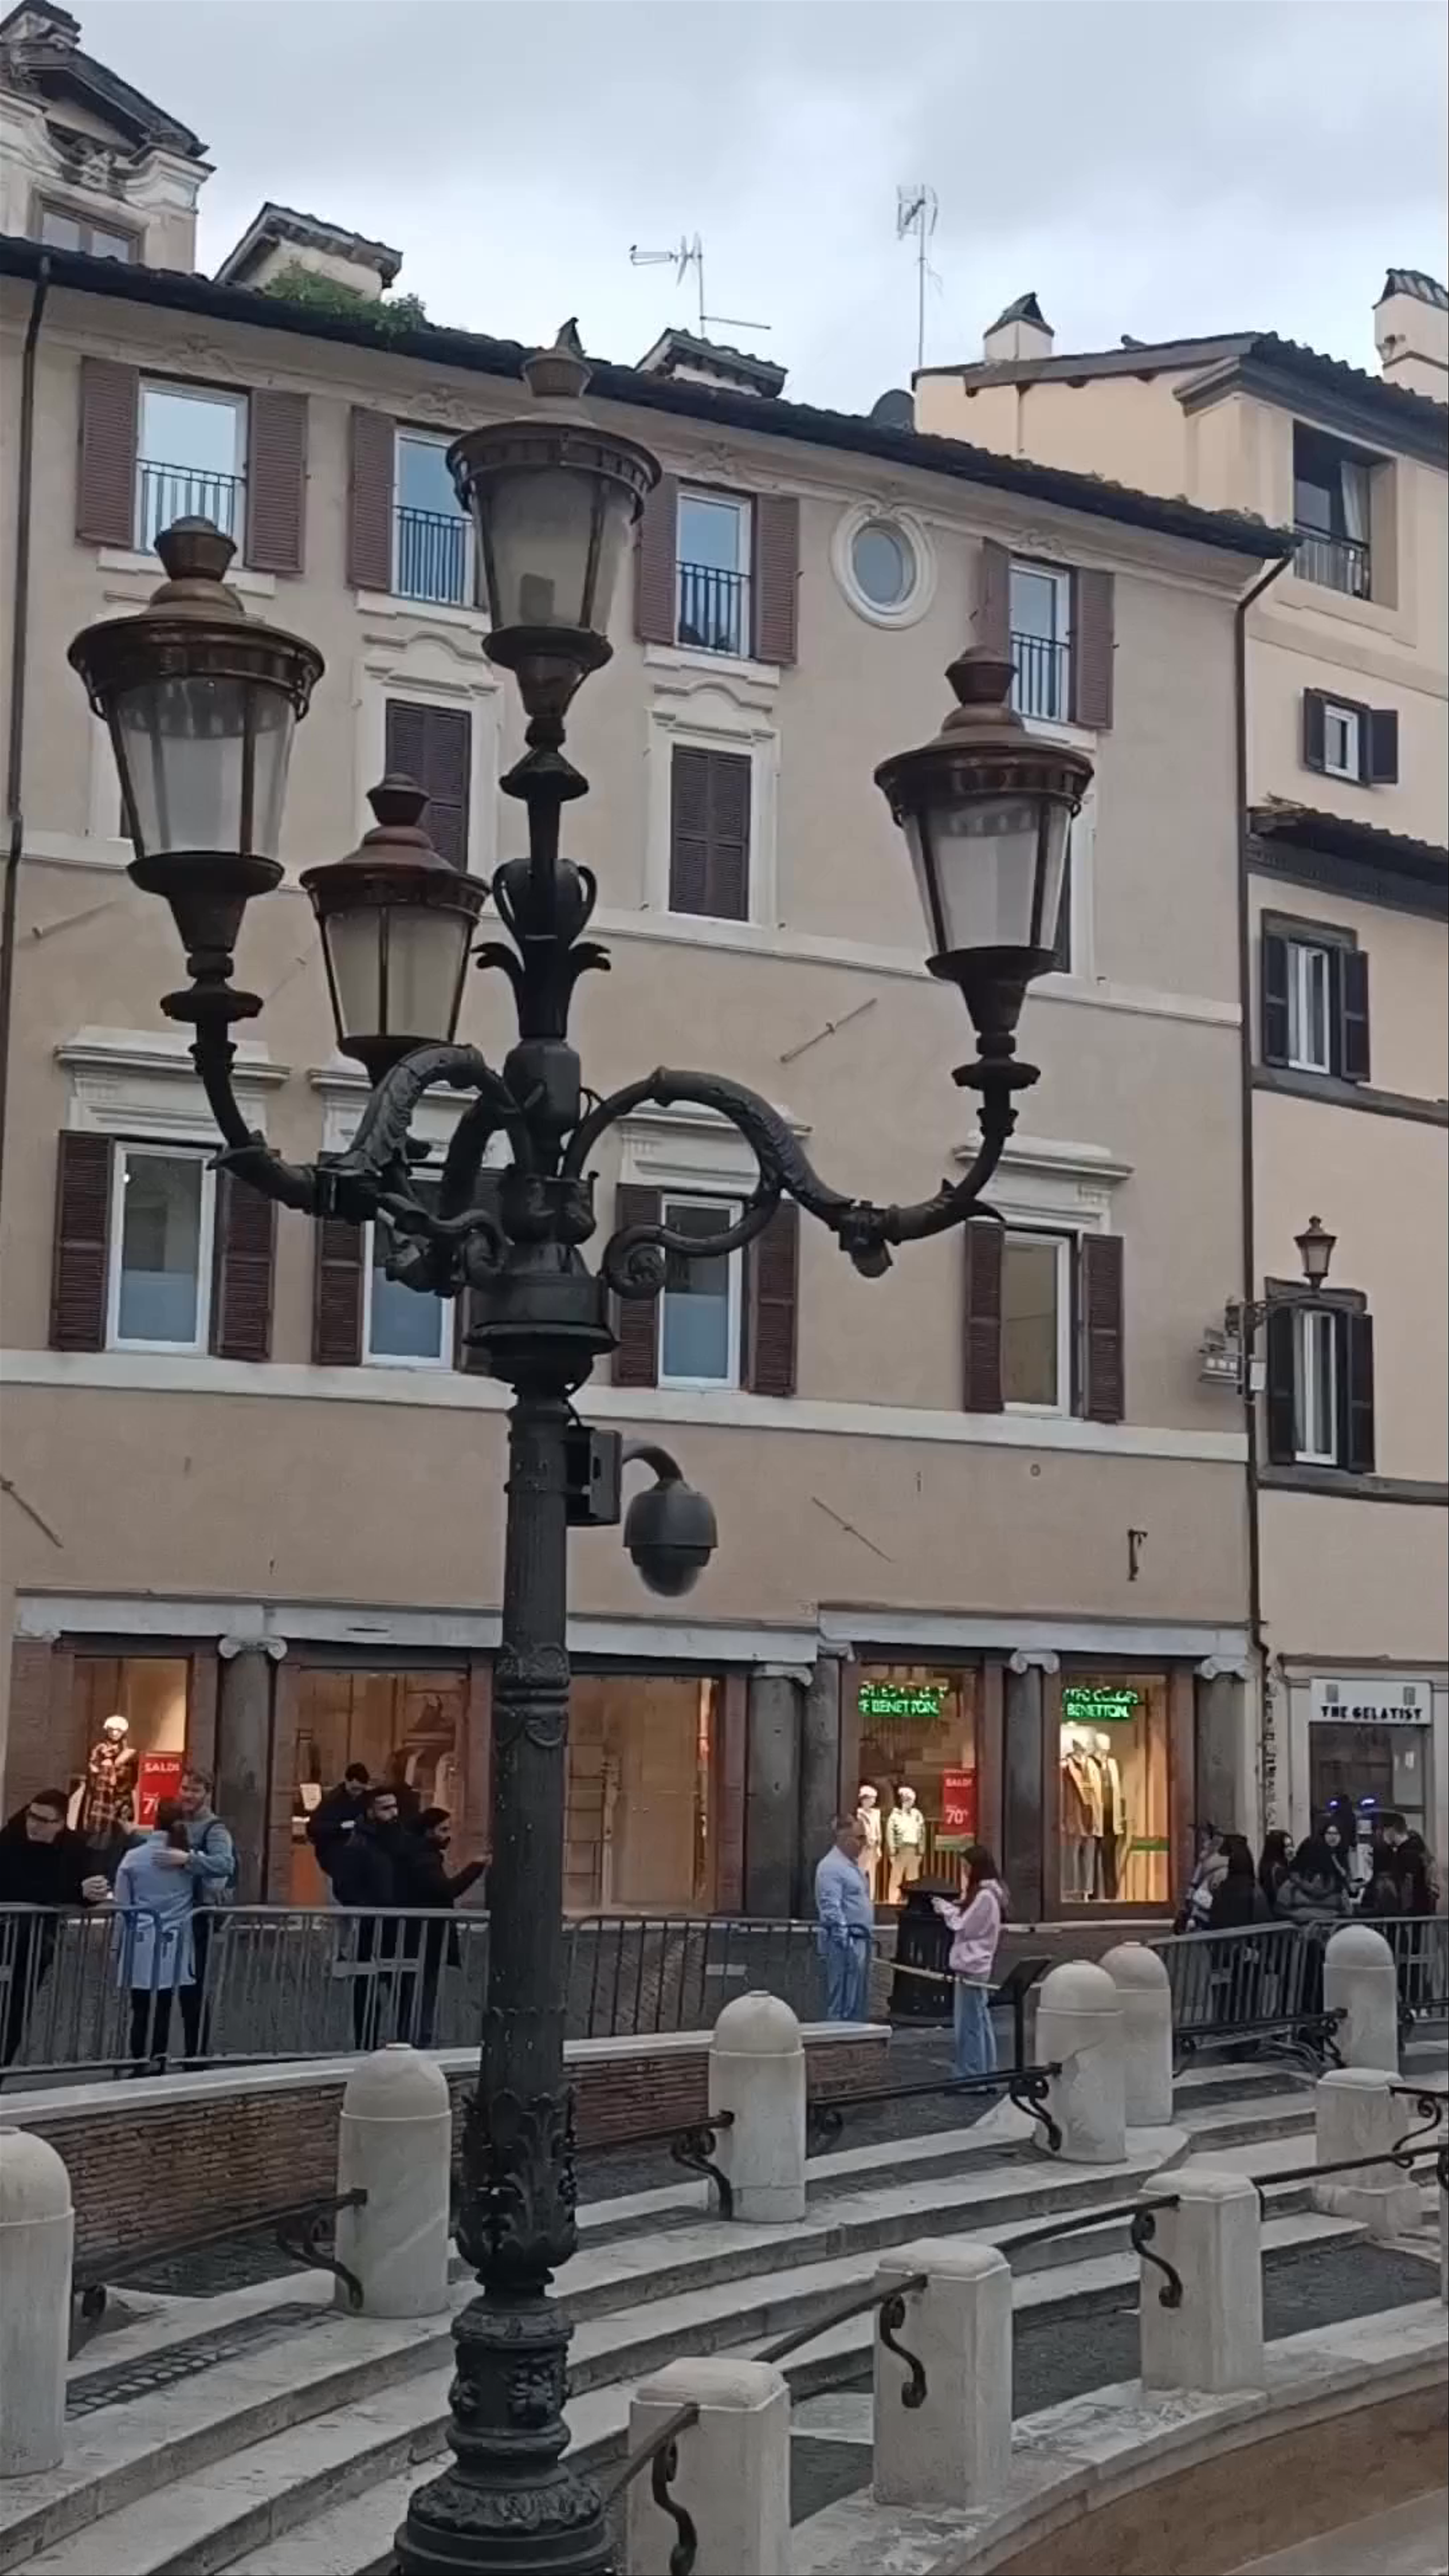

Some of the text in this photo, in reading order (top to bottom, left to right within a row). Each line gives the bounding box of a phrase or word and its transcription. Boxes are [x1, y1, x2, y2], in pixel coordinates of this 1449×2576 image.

[1321, 1706, 1422, 1720] THE GELATIST
[145, 1762, 180, 1772] SALDI
